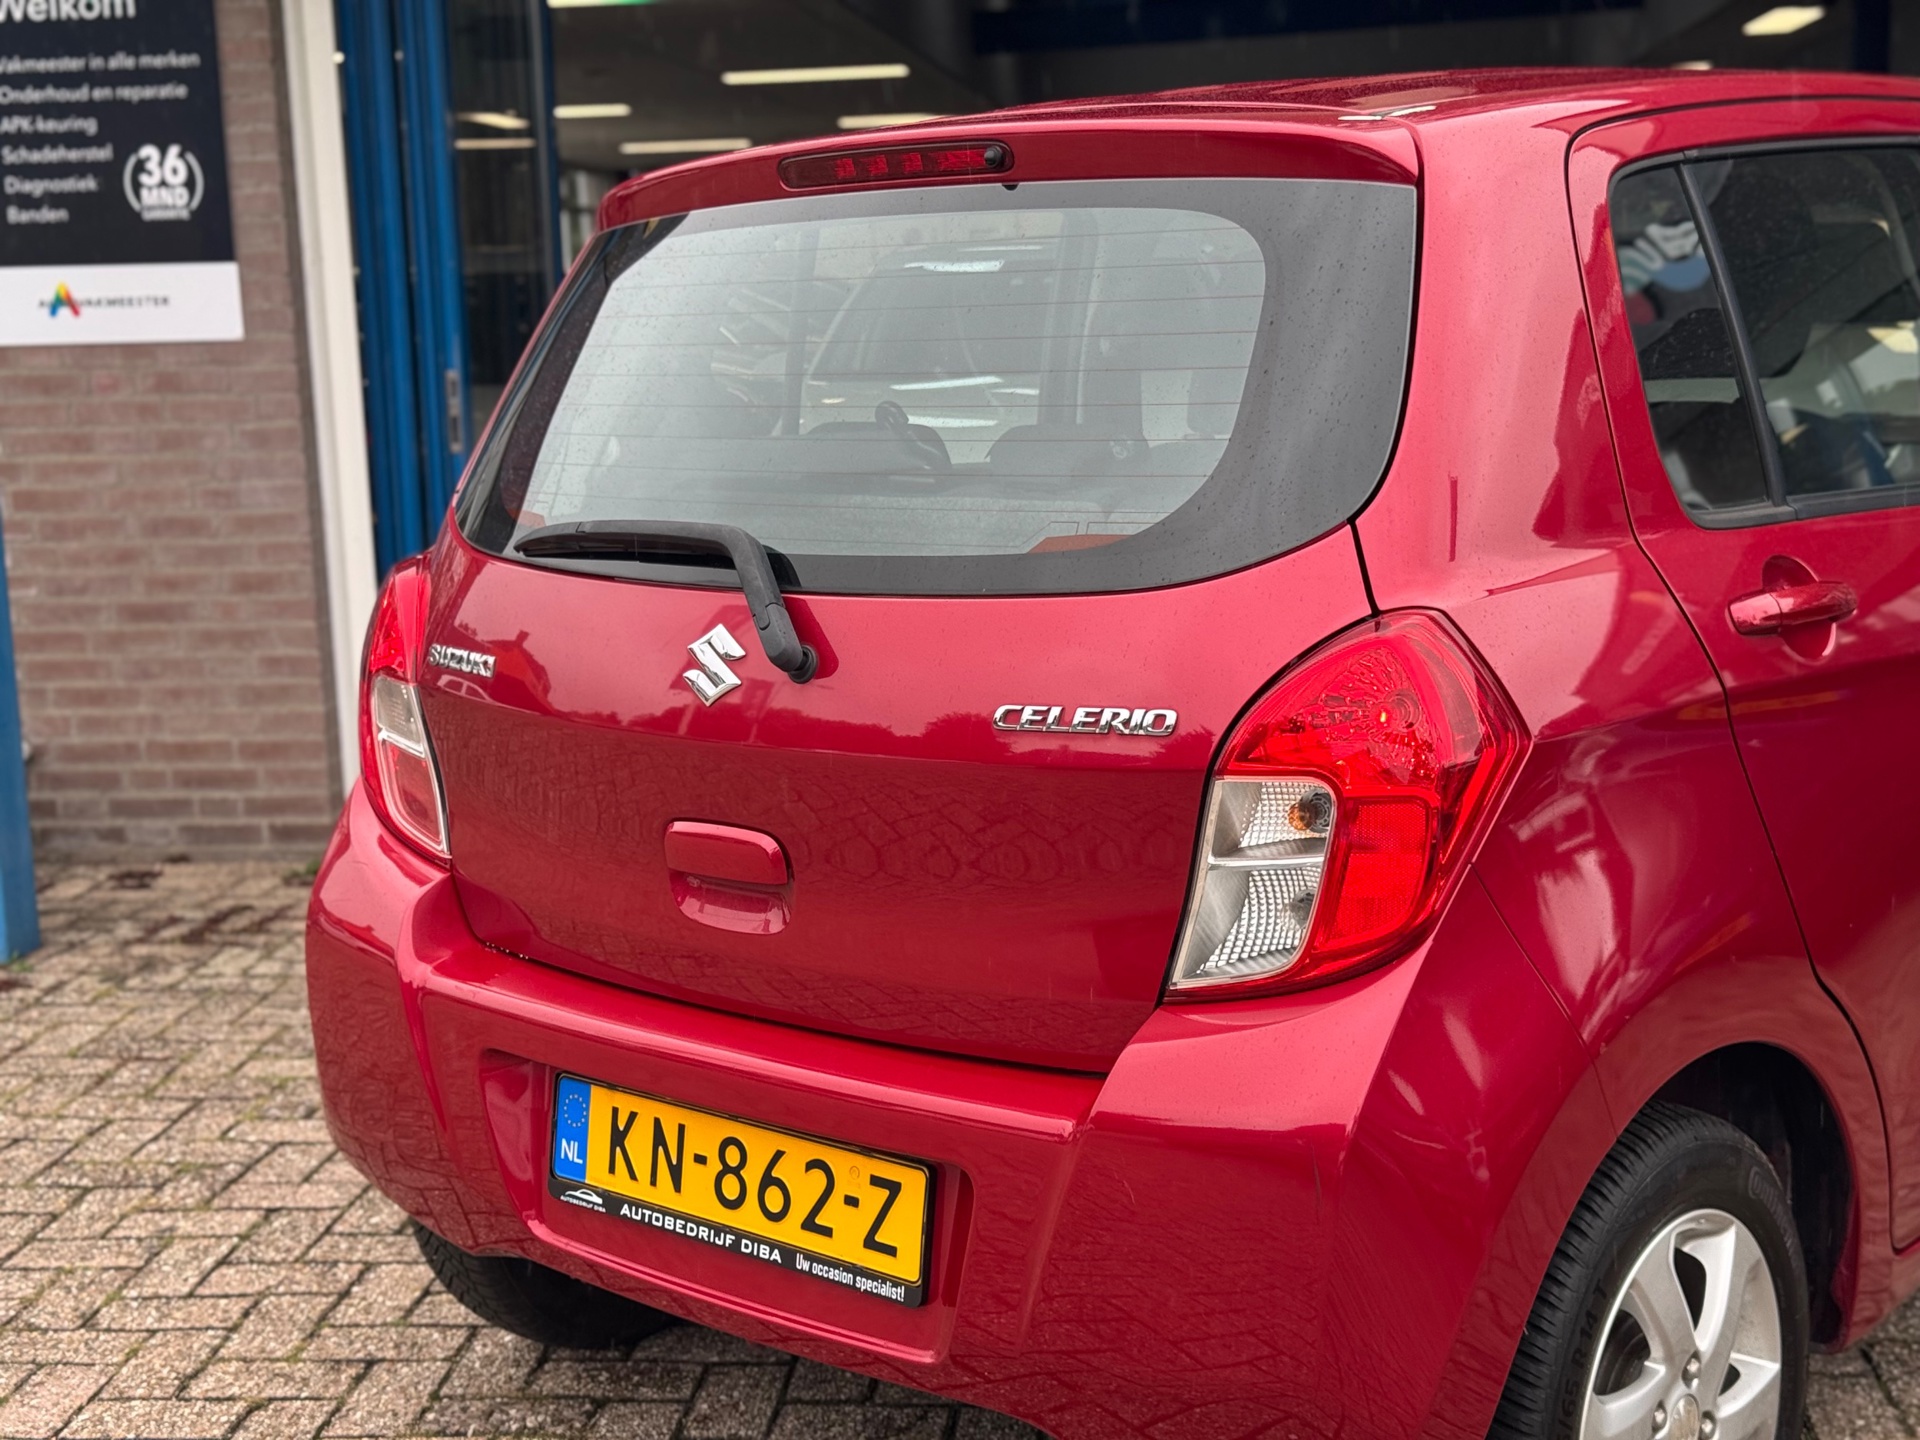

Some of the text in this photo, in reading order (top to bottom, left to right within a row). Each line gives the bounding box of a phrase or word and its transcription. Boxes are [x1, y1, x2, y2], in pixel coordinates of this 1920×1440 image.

[88, 52, 105, 70] in
[107, 51, 137, 71] alle
[138, 49, 201, 69] merken
[0, 80, 189, 106] Onderhoud en reparatie
[1, 142, 114, 165] Schadeherstel
[138, 143, 188, 187] 36
[4, 172, 99, 199] Diagnostiek
[6, 203, 70, 225] Banden
[428, 643, 496, 678] SUZUKI
[993, 704, 1179, 737] CELERIO
[560, 1138, 583, 1165] NL
[608, 1105, 902, 1258] KN-862-Z
[619, 1203, 905, 1302] AUTOBEDRIJF DIBA Uw occasion specialist!
